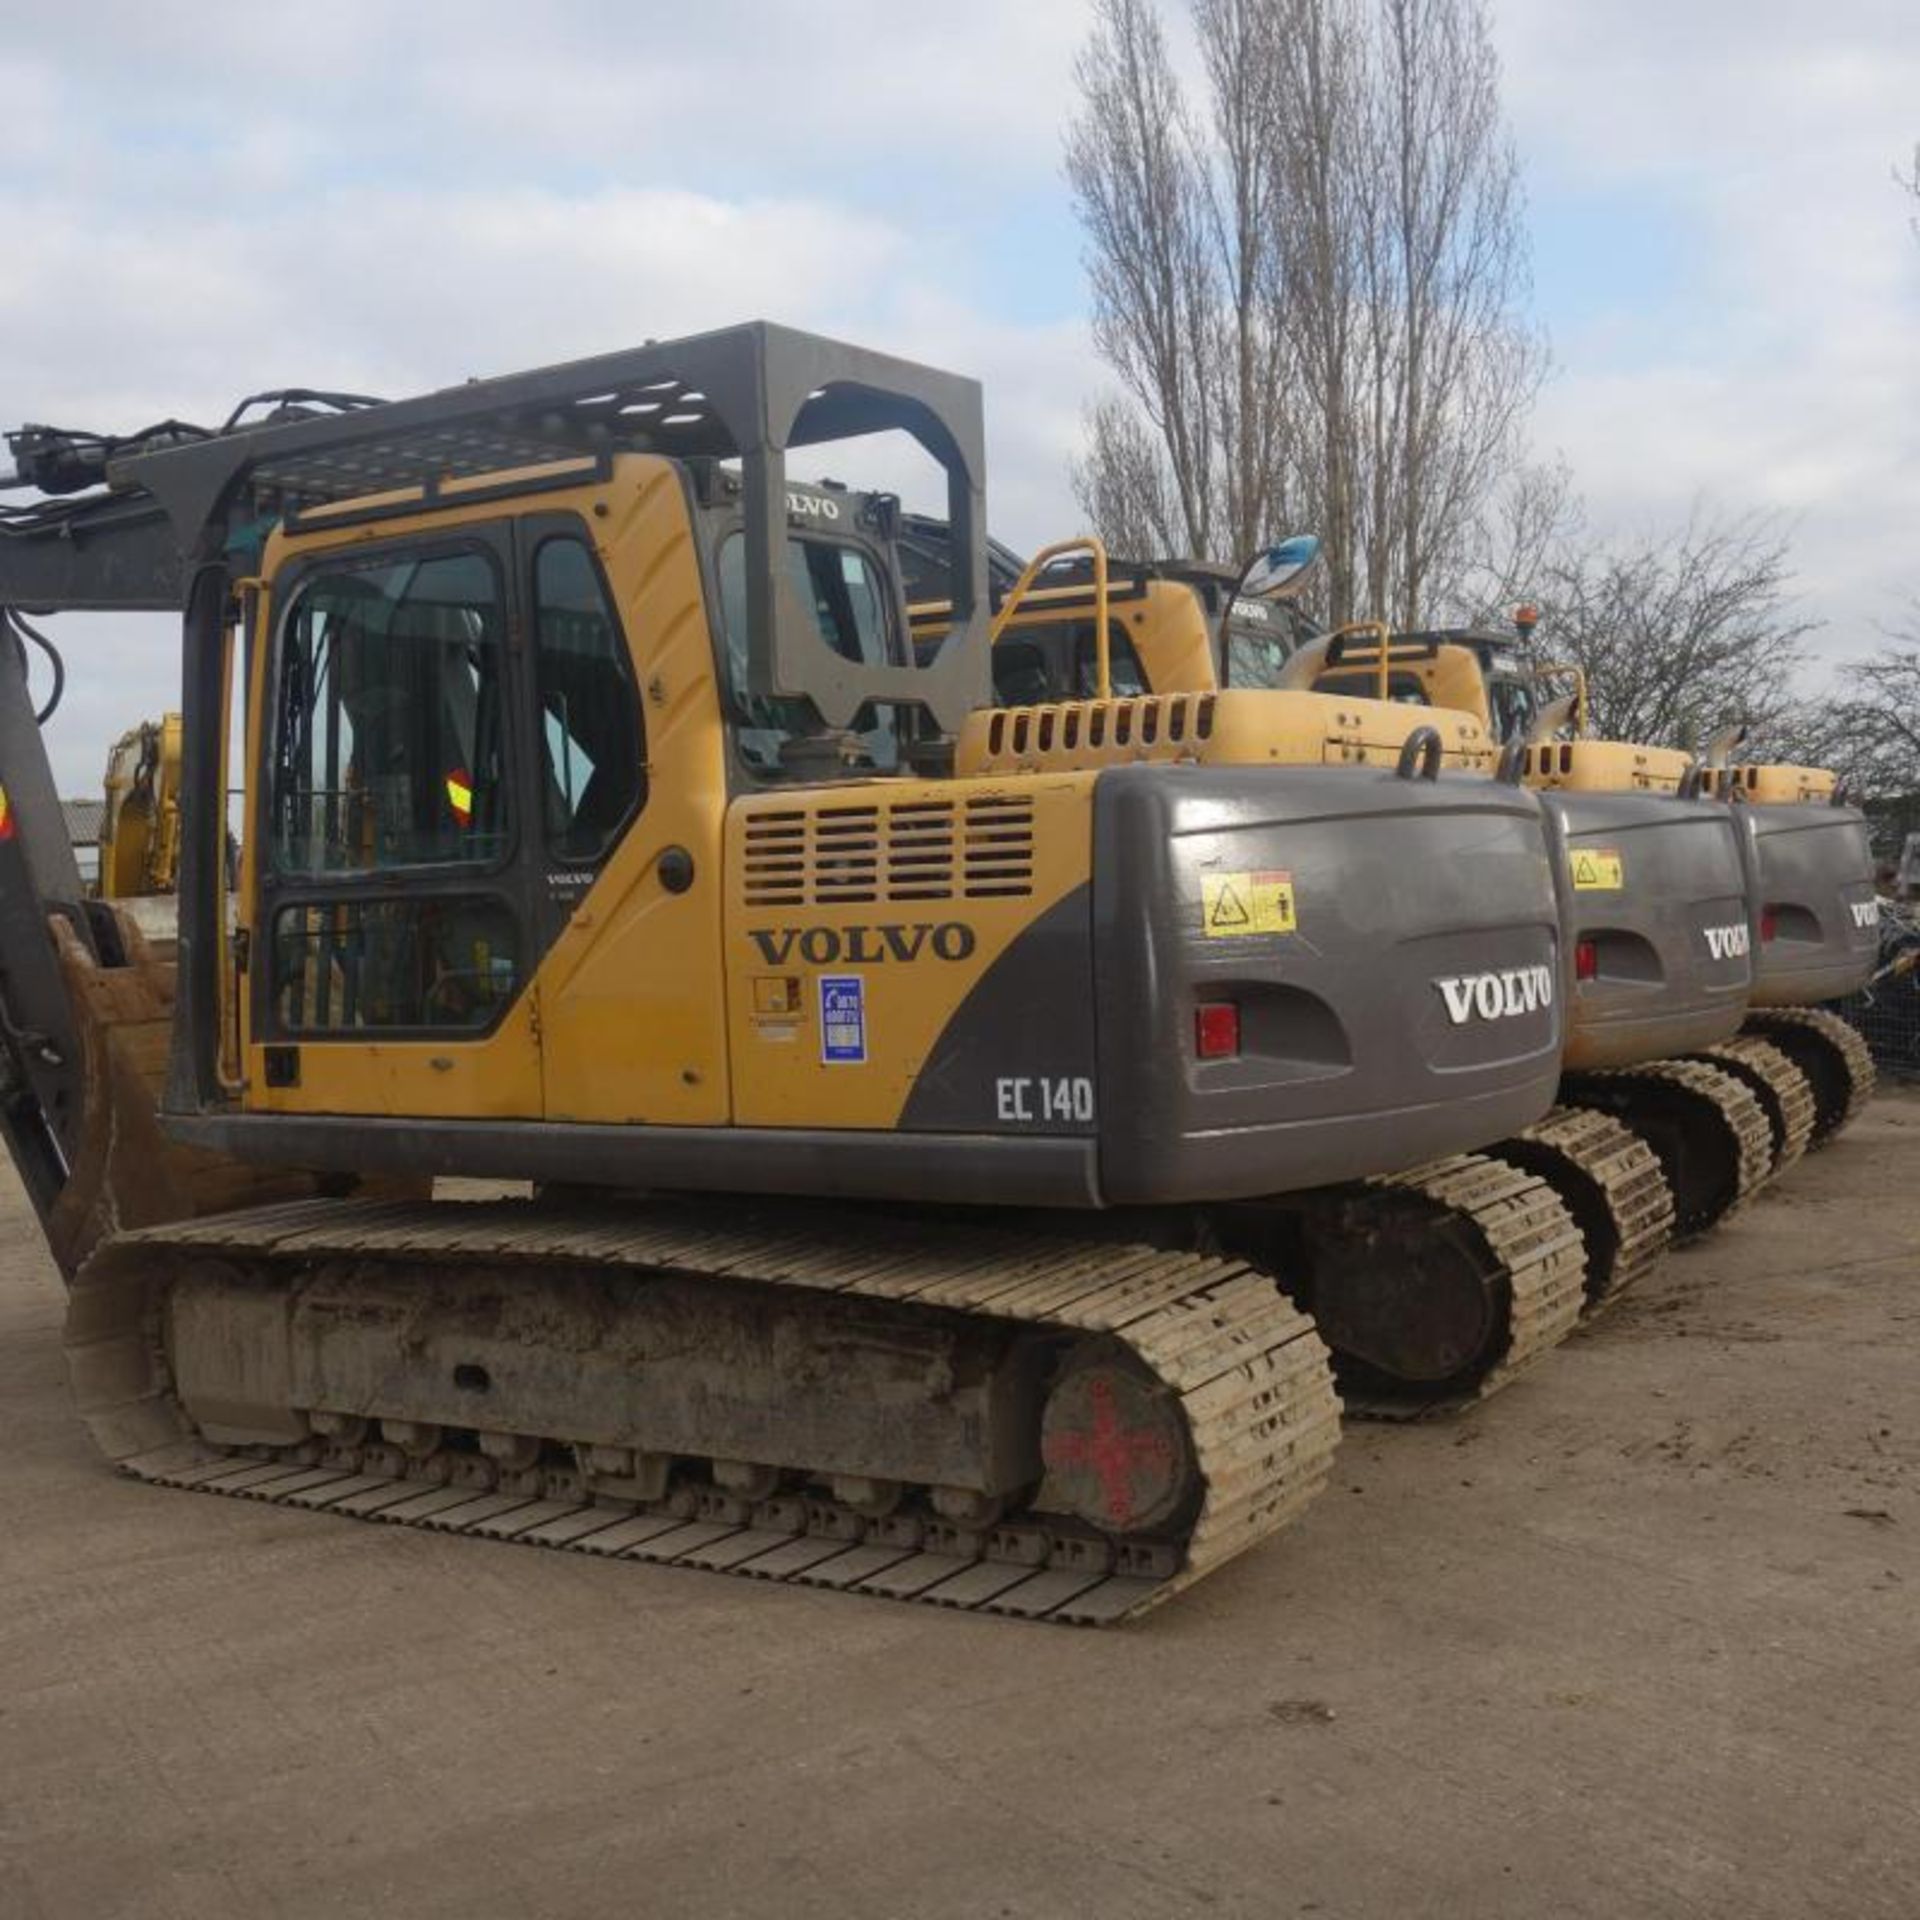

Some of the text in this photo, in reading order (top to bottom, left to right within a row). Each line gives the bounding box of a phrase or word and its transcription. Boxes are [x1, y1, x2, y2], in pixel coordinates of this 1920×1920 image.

[786, 493, 838, 519] LVO
[748, 922, 976, 966] VOLVO
[1437, 965, 1552, 1025] VOLVO
[997, 1078, 1093, 1122] EC 140
